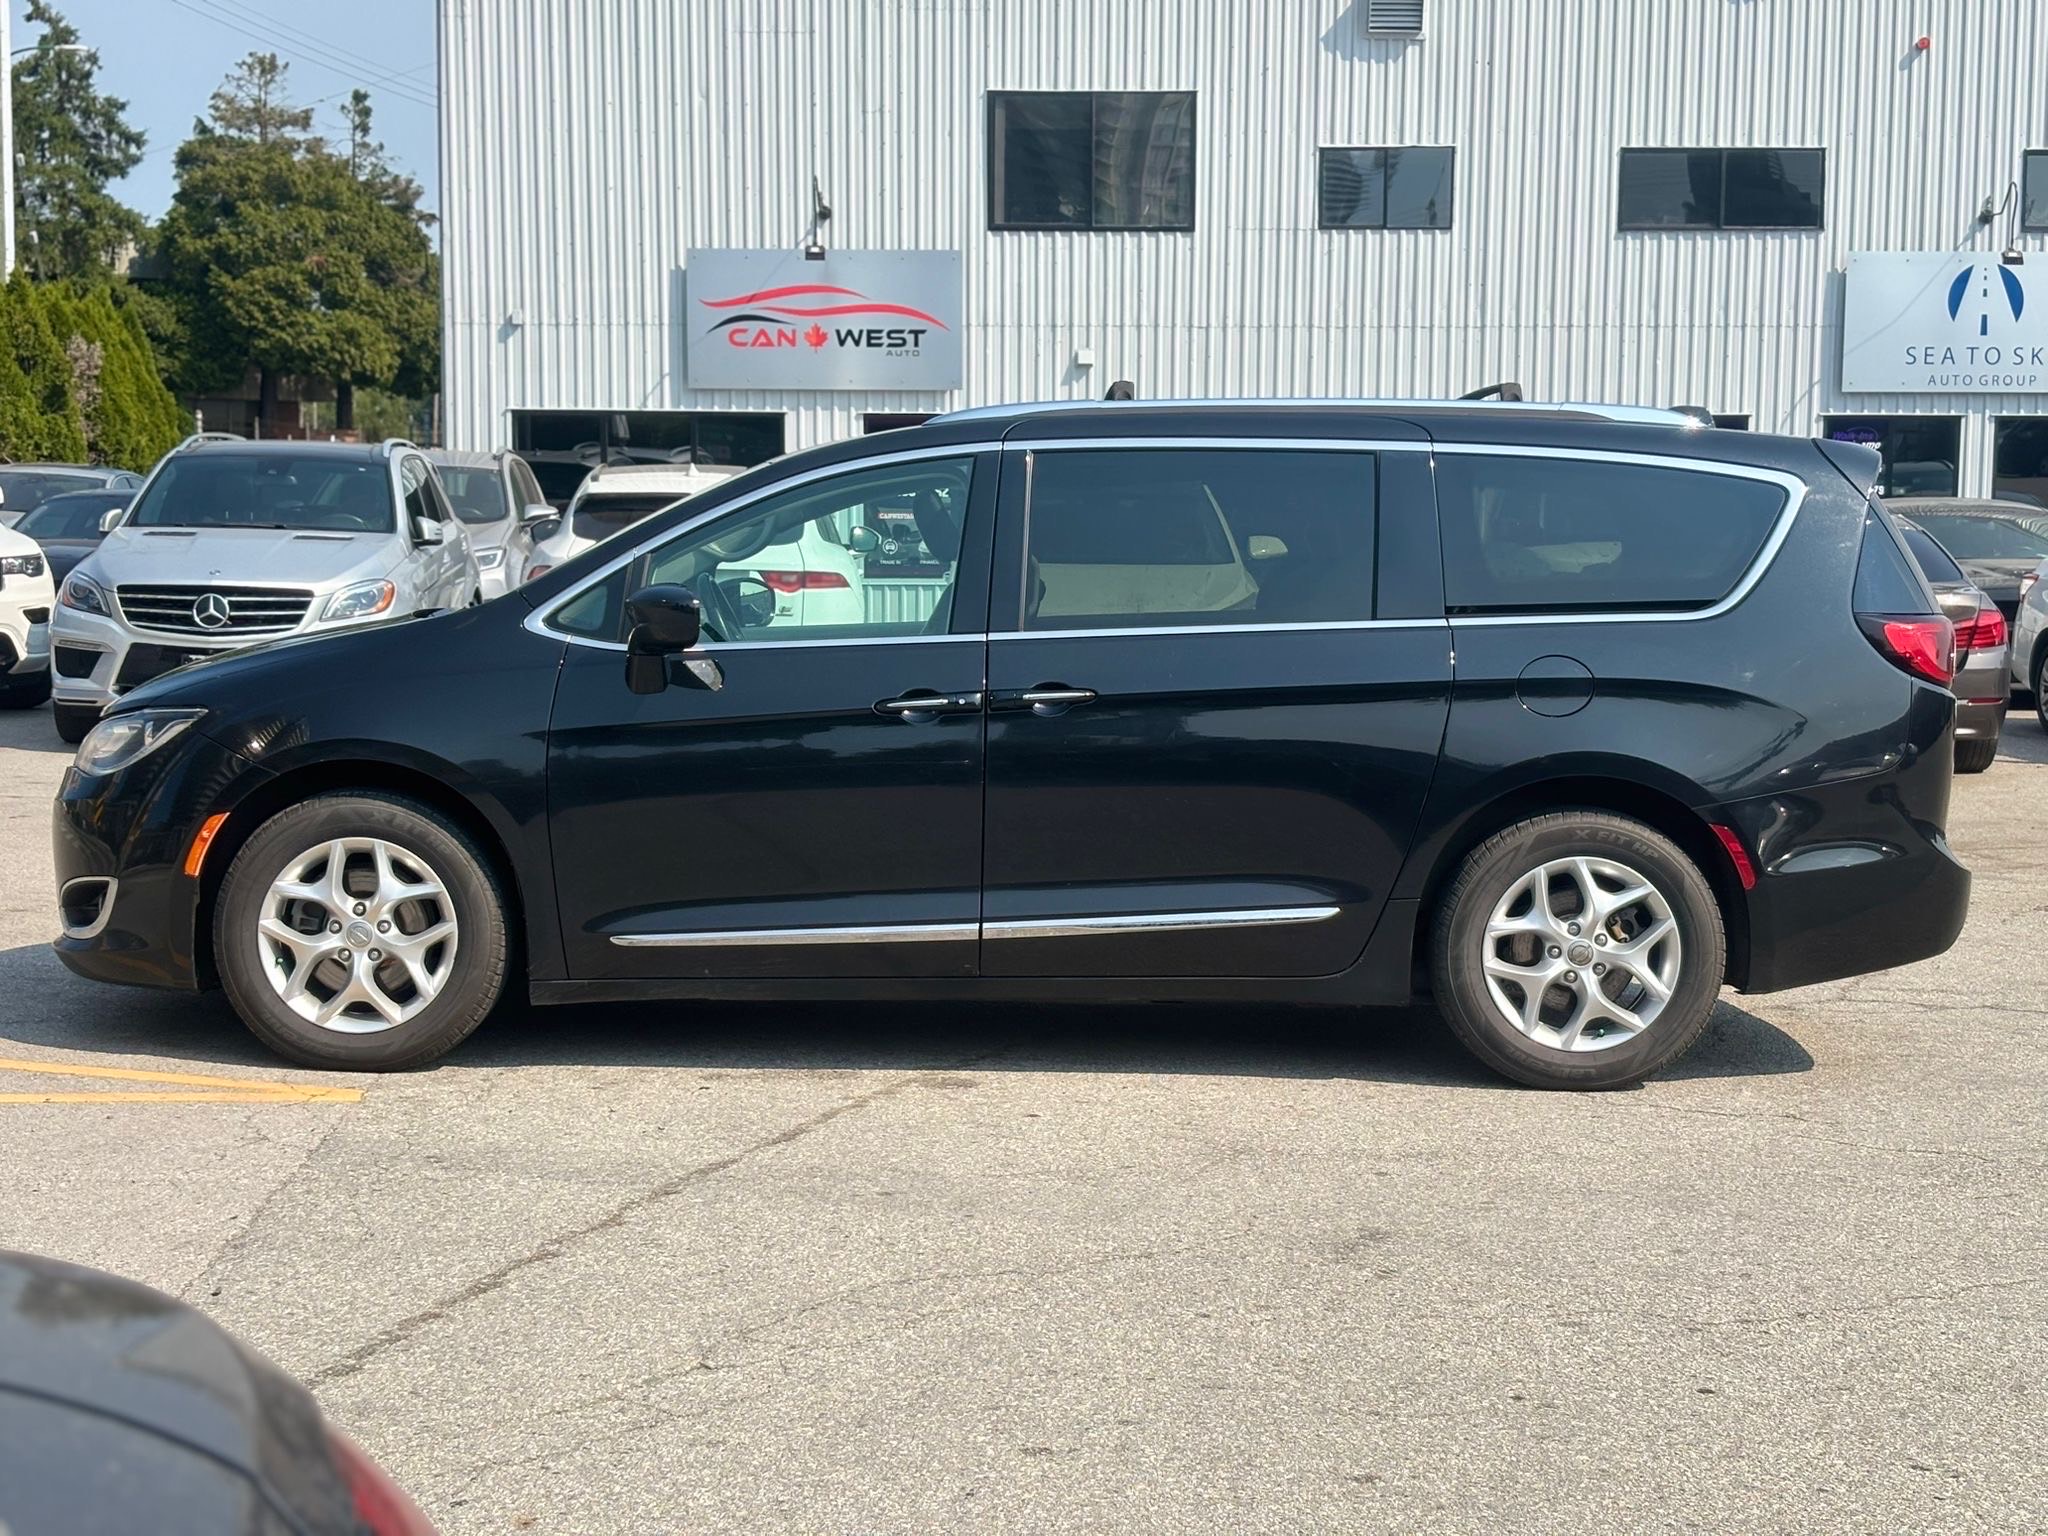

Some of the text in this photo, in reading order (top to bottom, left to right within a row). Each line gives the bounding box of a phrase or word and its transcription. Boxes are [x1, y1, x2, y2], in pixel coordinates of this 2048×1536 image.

[728, 328, 928, 348] CAN WEST
[1905, 346, 2045, 365] SEA TO SK
[1928, 374, 2037, 386] AUTO GROUP
[1571, 829, 1659, 859] X FIT HP
